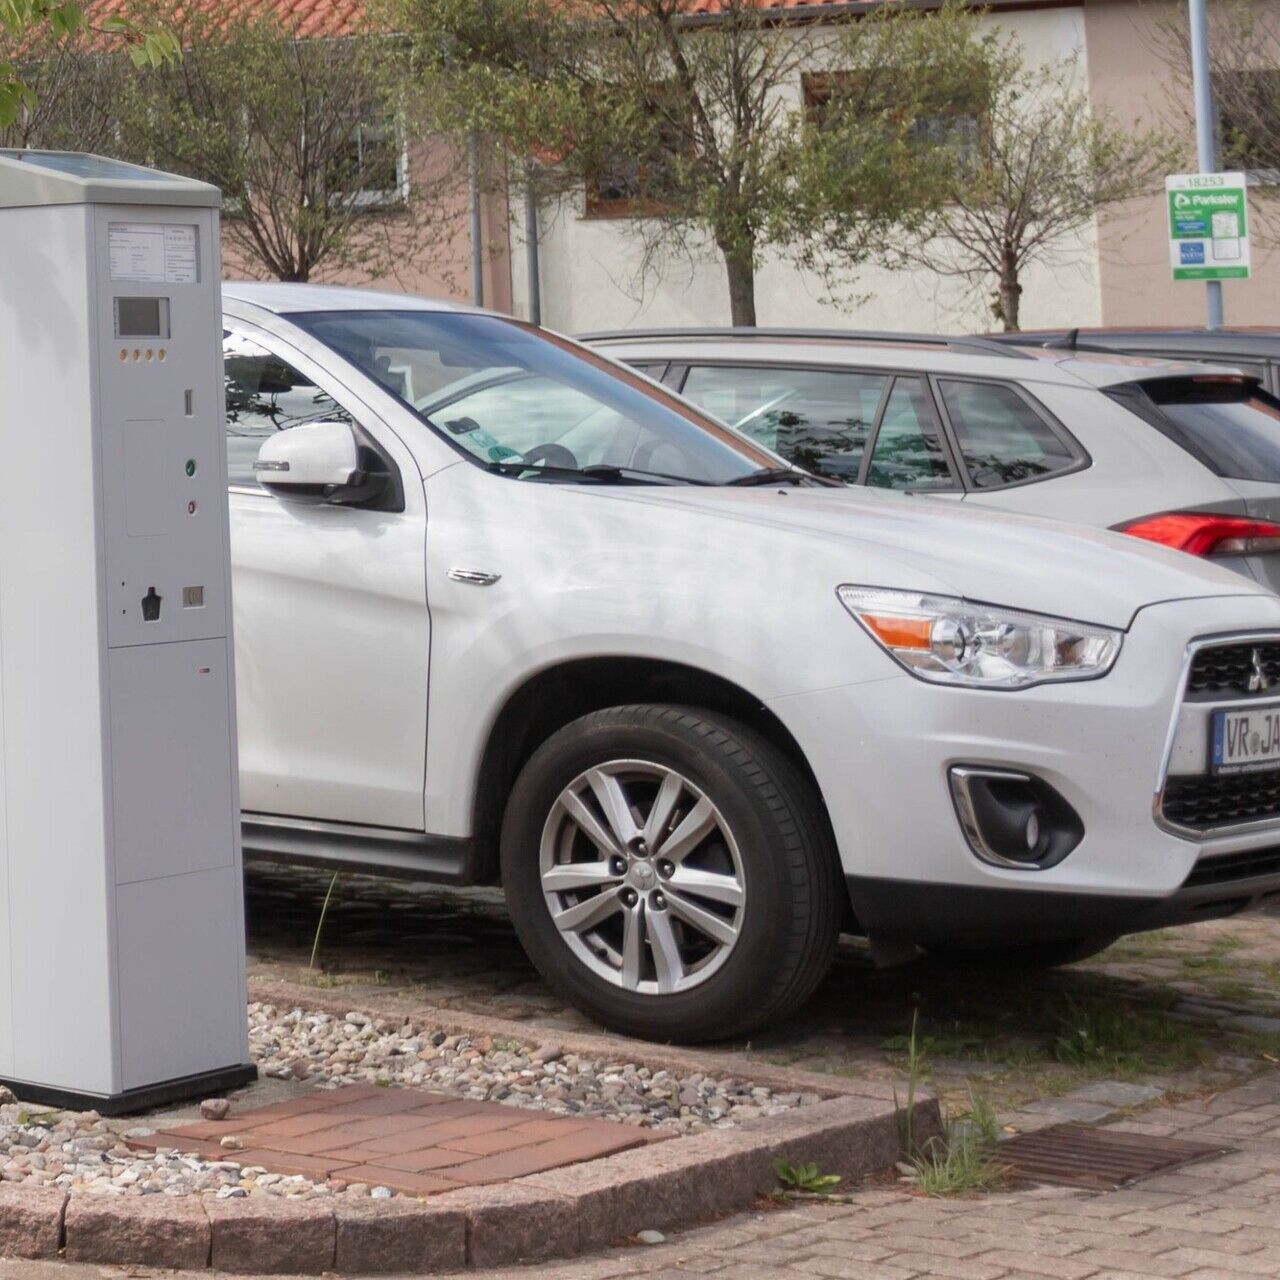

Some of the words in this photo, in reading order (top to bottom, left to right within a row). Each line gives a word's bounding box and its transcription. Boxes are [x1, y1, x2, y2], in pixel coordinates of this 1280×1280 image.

[1188, 176, 1225, 188] 18253
[1227, 717, 1249, 757] VR
[1261, 715, 1280, 752] JA
